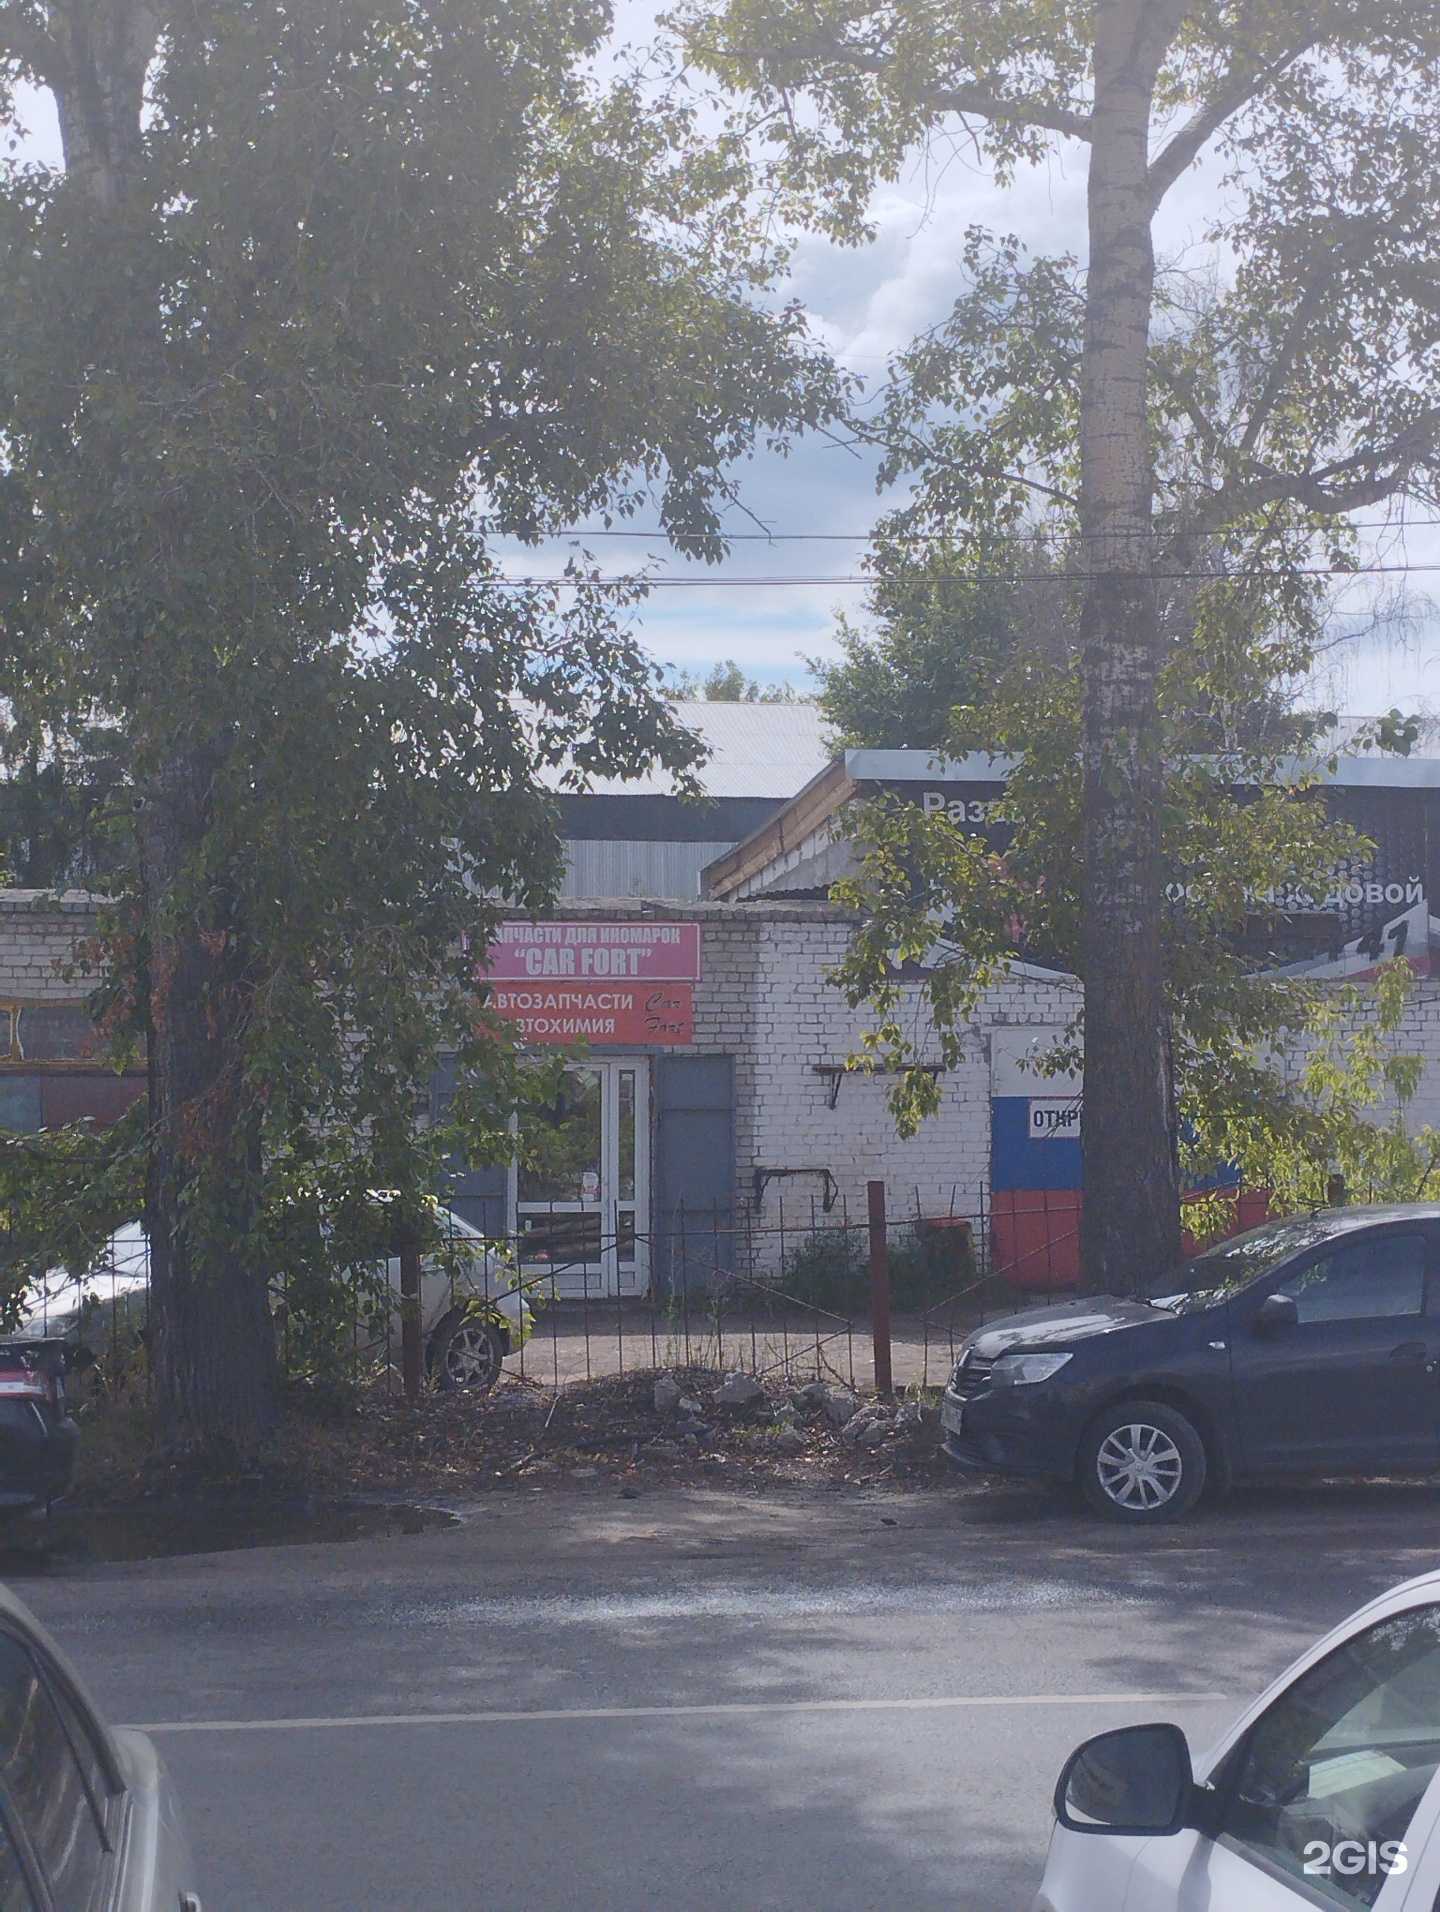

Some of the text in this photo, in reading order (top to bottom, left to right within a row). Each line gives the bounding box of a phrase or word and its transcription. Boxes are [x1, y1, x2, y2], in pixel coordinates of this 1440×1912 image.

[494, 927, 562, 944] АПЧАСТИ
[600, 927, 681, 944] ИНОМАРОК
[482, 993, 633, 1009] АВТОЗАПЧАСТИ
[503, 1018, 615, 1034] ВТОХИМИЯ
[1033, 1110, 1079, 1128] ОТКР
